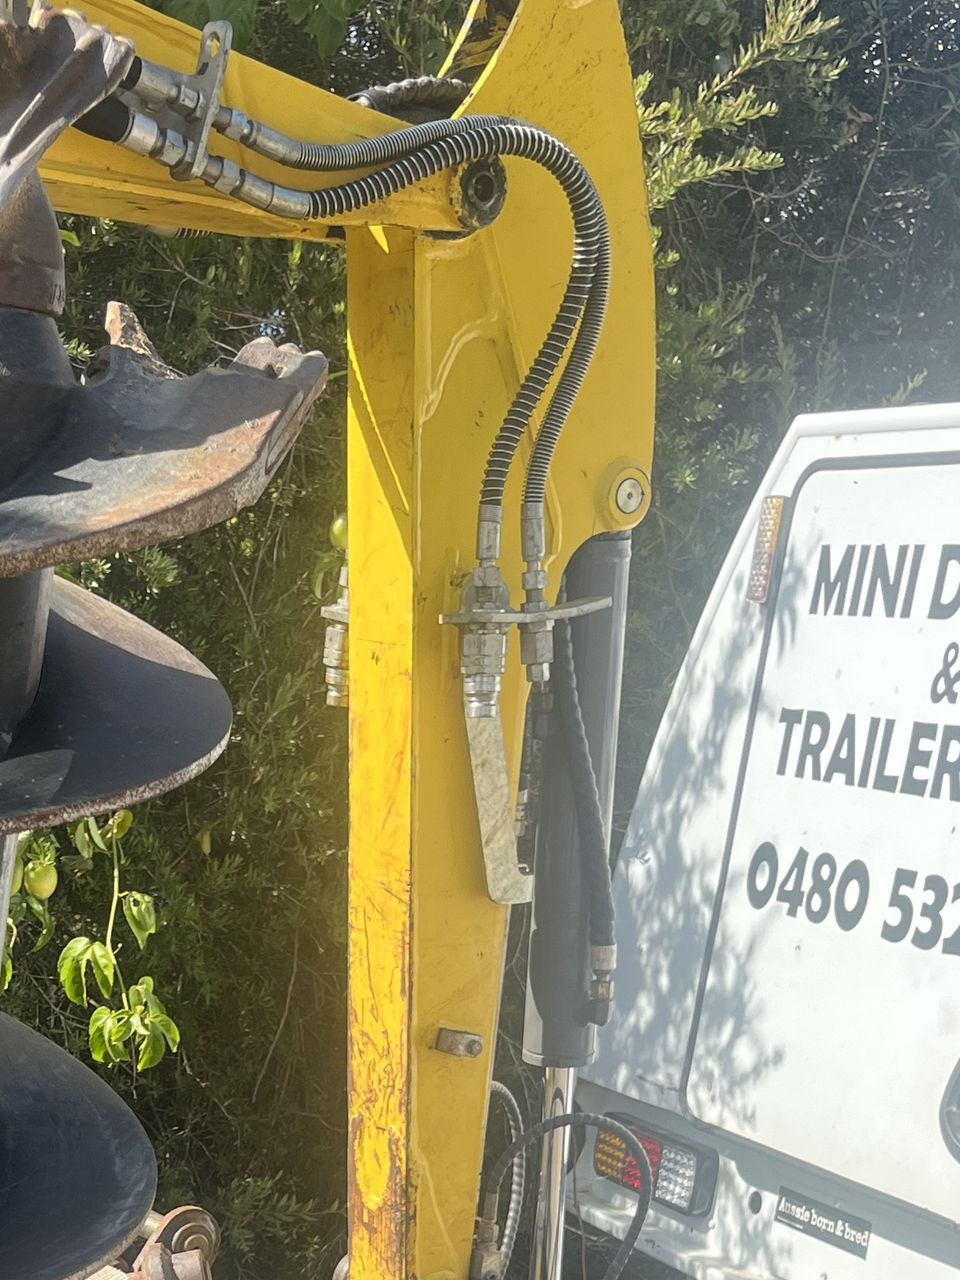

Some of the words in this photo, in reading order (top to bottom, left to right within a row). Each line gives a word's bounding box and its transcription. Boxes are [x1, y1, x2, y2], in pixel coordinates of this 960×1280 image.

[808, 544, 926, 619] MINI
[929, 641, 960, 704] &
[776, 706, 960, 802] TRAILER
[746, 841, 870, 932] 0480
[778, 1196, 810, 1222] Aussie
[810, 1208, 835, 1233] born
[835, 1219, 845, 1237] &
[844, 1222, 869, 1247] bred
